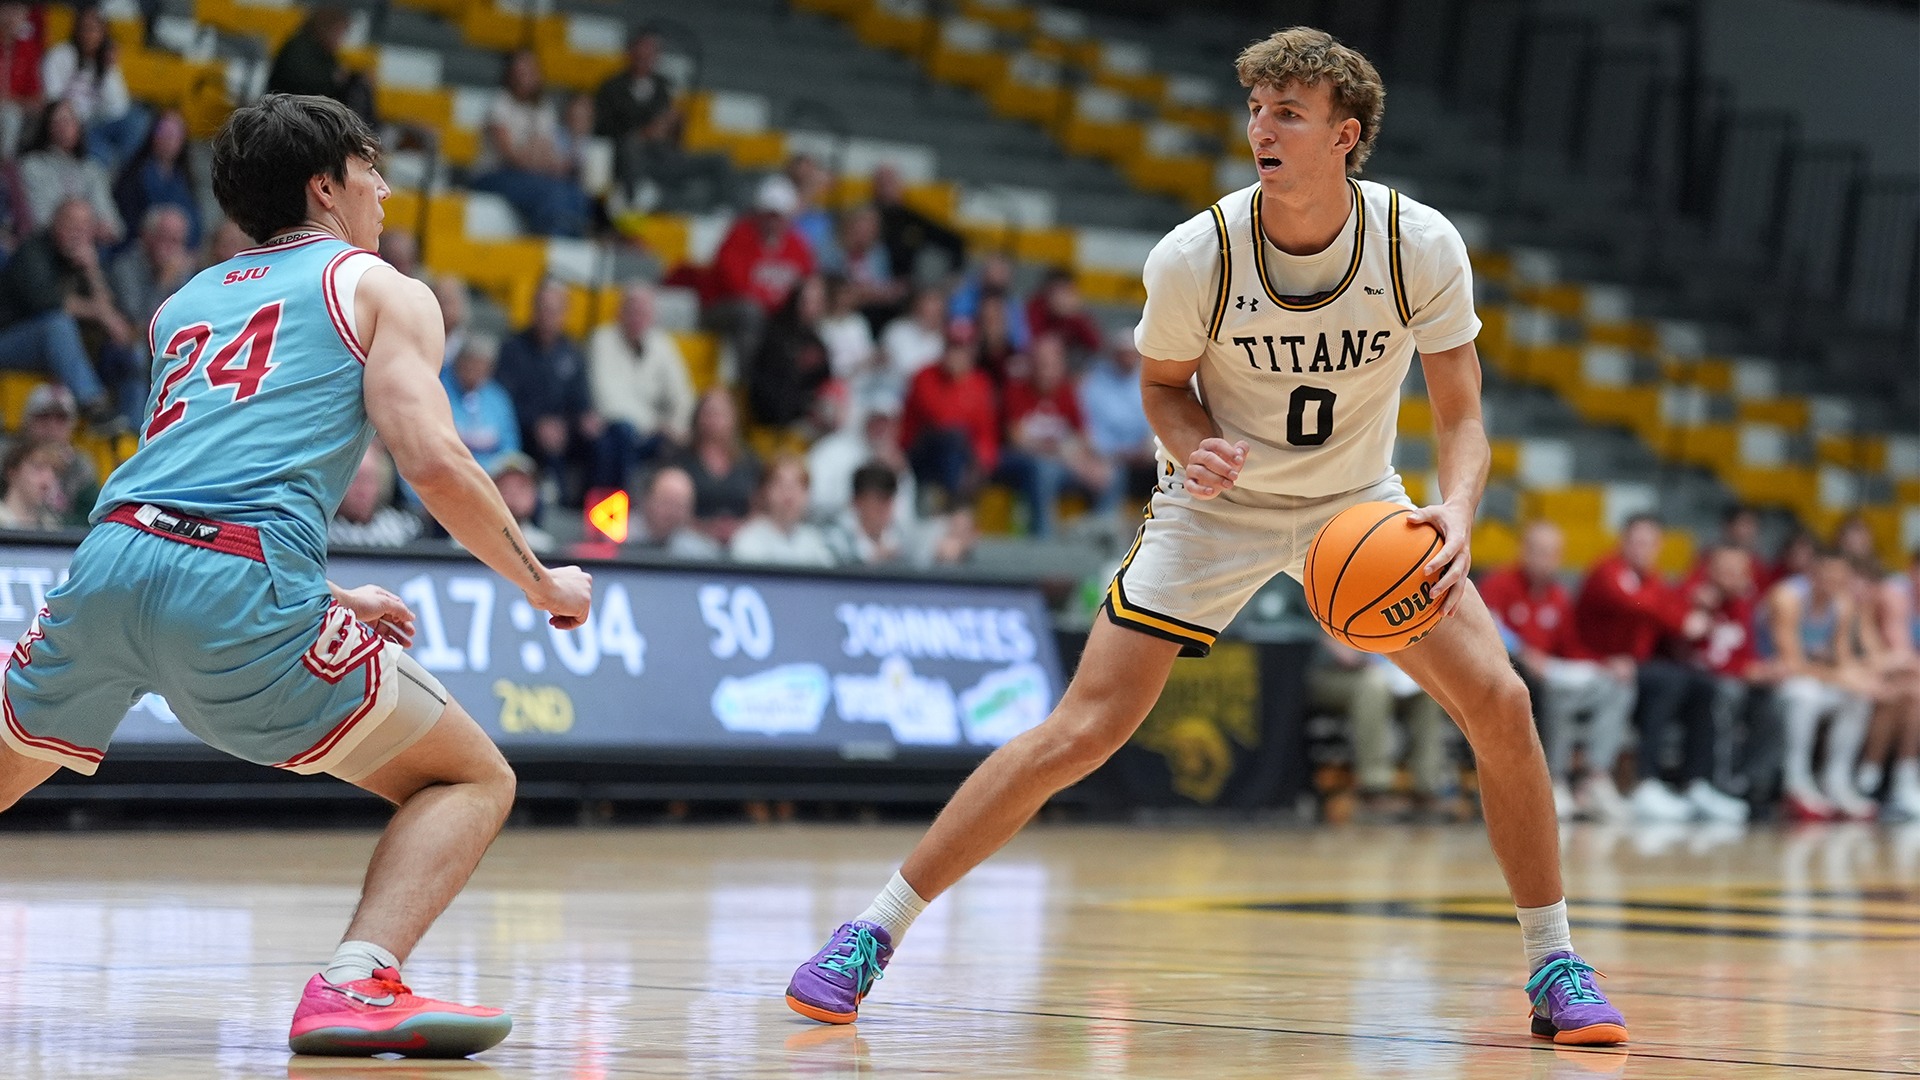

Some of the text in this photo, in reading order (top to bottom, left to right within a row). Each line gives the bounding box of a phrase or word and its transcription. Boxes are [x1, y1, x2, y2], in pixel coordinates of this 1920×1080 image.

[285, 232, 311, 243] PRO
[223, 266, 271, 286] SJU
[145, 298, 285, 442] 24
[1233, 330, 1391, 373] TITANS
[1286, 385, 1337, 446] 0
[697, 585, 773, 660] 50
[1380, 581, 1436, 627] Wil
[493, 678, 574, 734] 2ND
